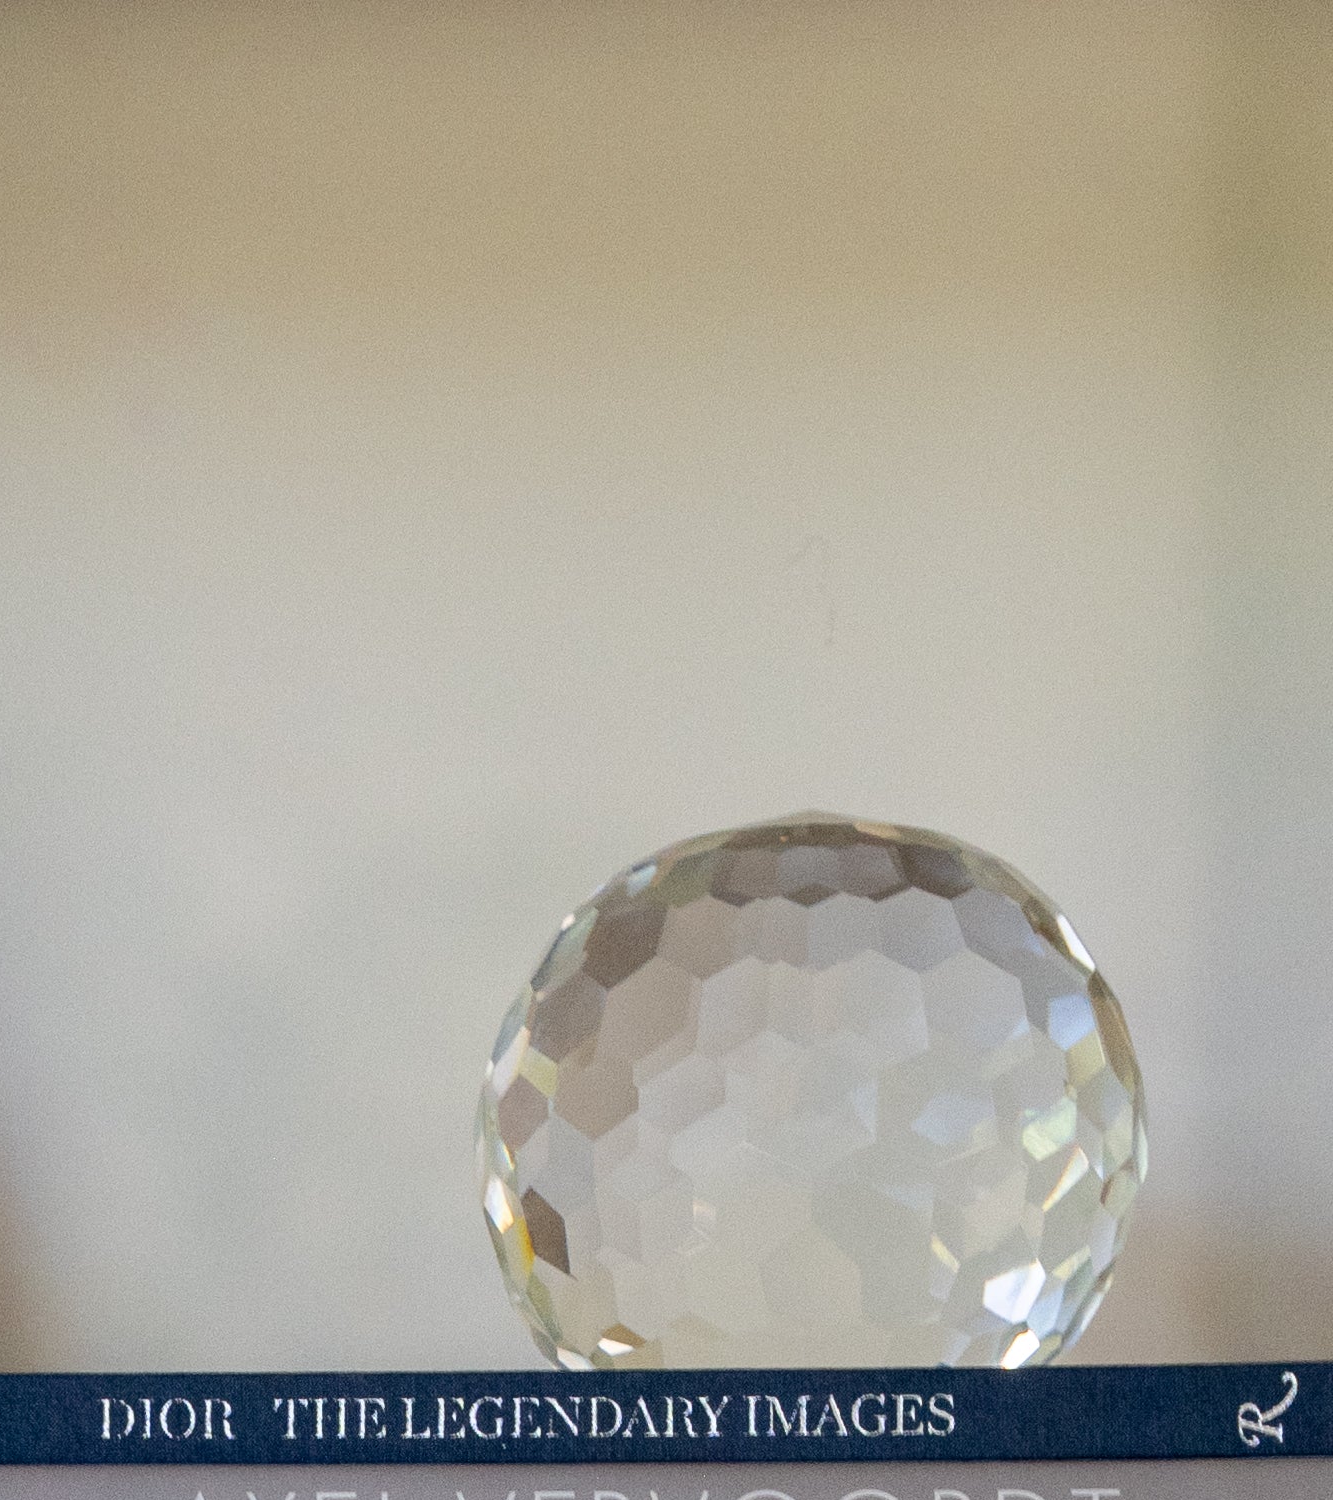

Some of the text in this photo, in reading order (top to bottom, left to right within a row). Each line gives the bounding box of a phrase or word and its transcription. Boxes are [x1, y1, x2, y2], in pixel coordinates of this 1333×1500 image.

[100, 1393, 957, 1440] DIOR THE LEGENDARY IMAGES
